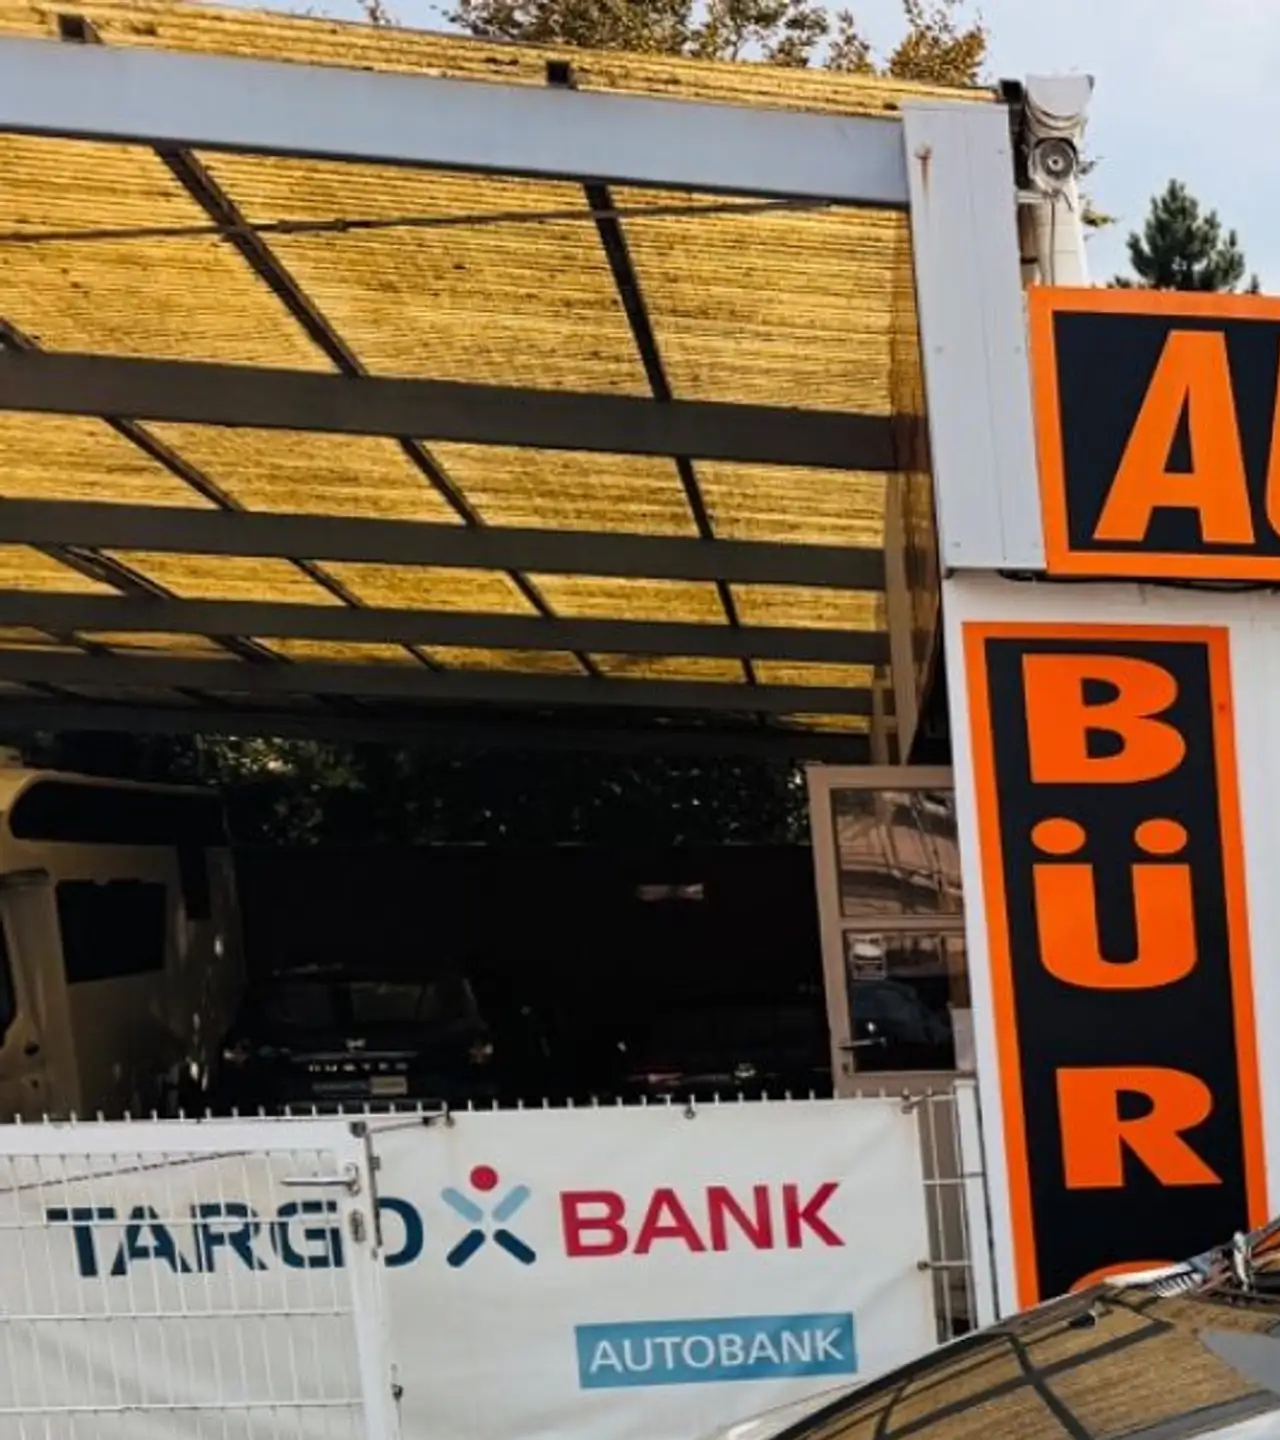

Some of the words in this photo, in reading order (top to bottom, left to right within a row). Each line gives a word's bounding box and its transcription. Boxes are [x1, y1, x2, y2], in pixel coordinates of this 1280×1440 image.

[1022, 653, 1223, 1292] BÜR
[559, 1181, 846, 1259] BANK
[589, 1326, 844, 1375] AUTOBANK
